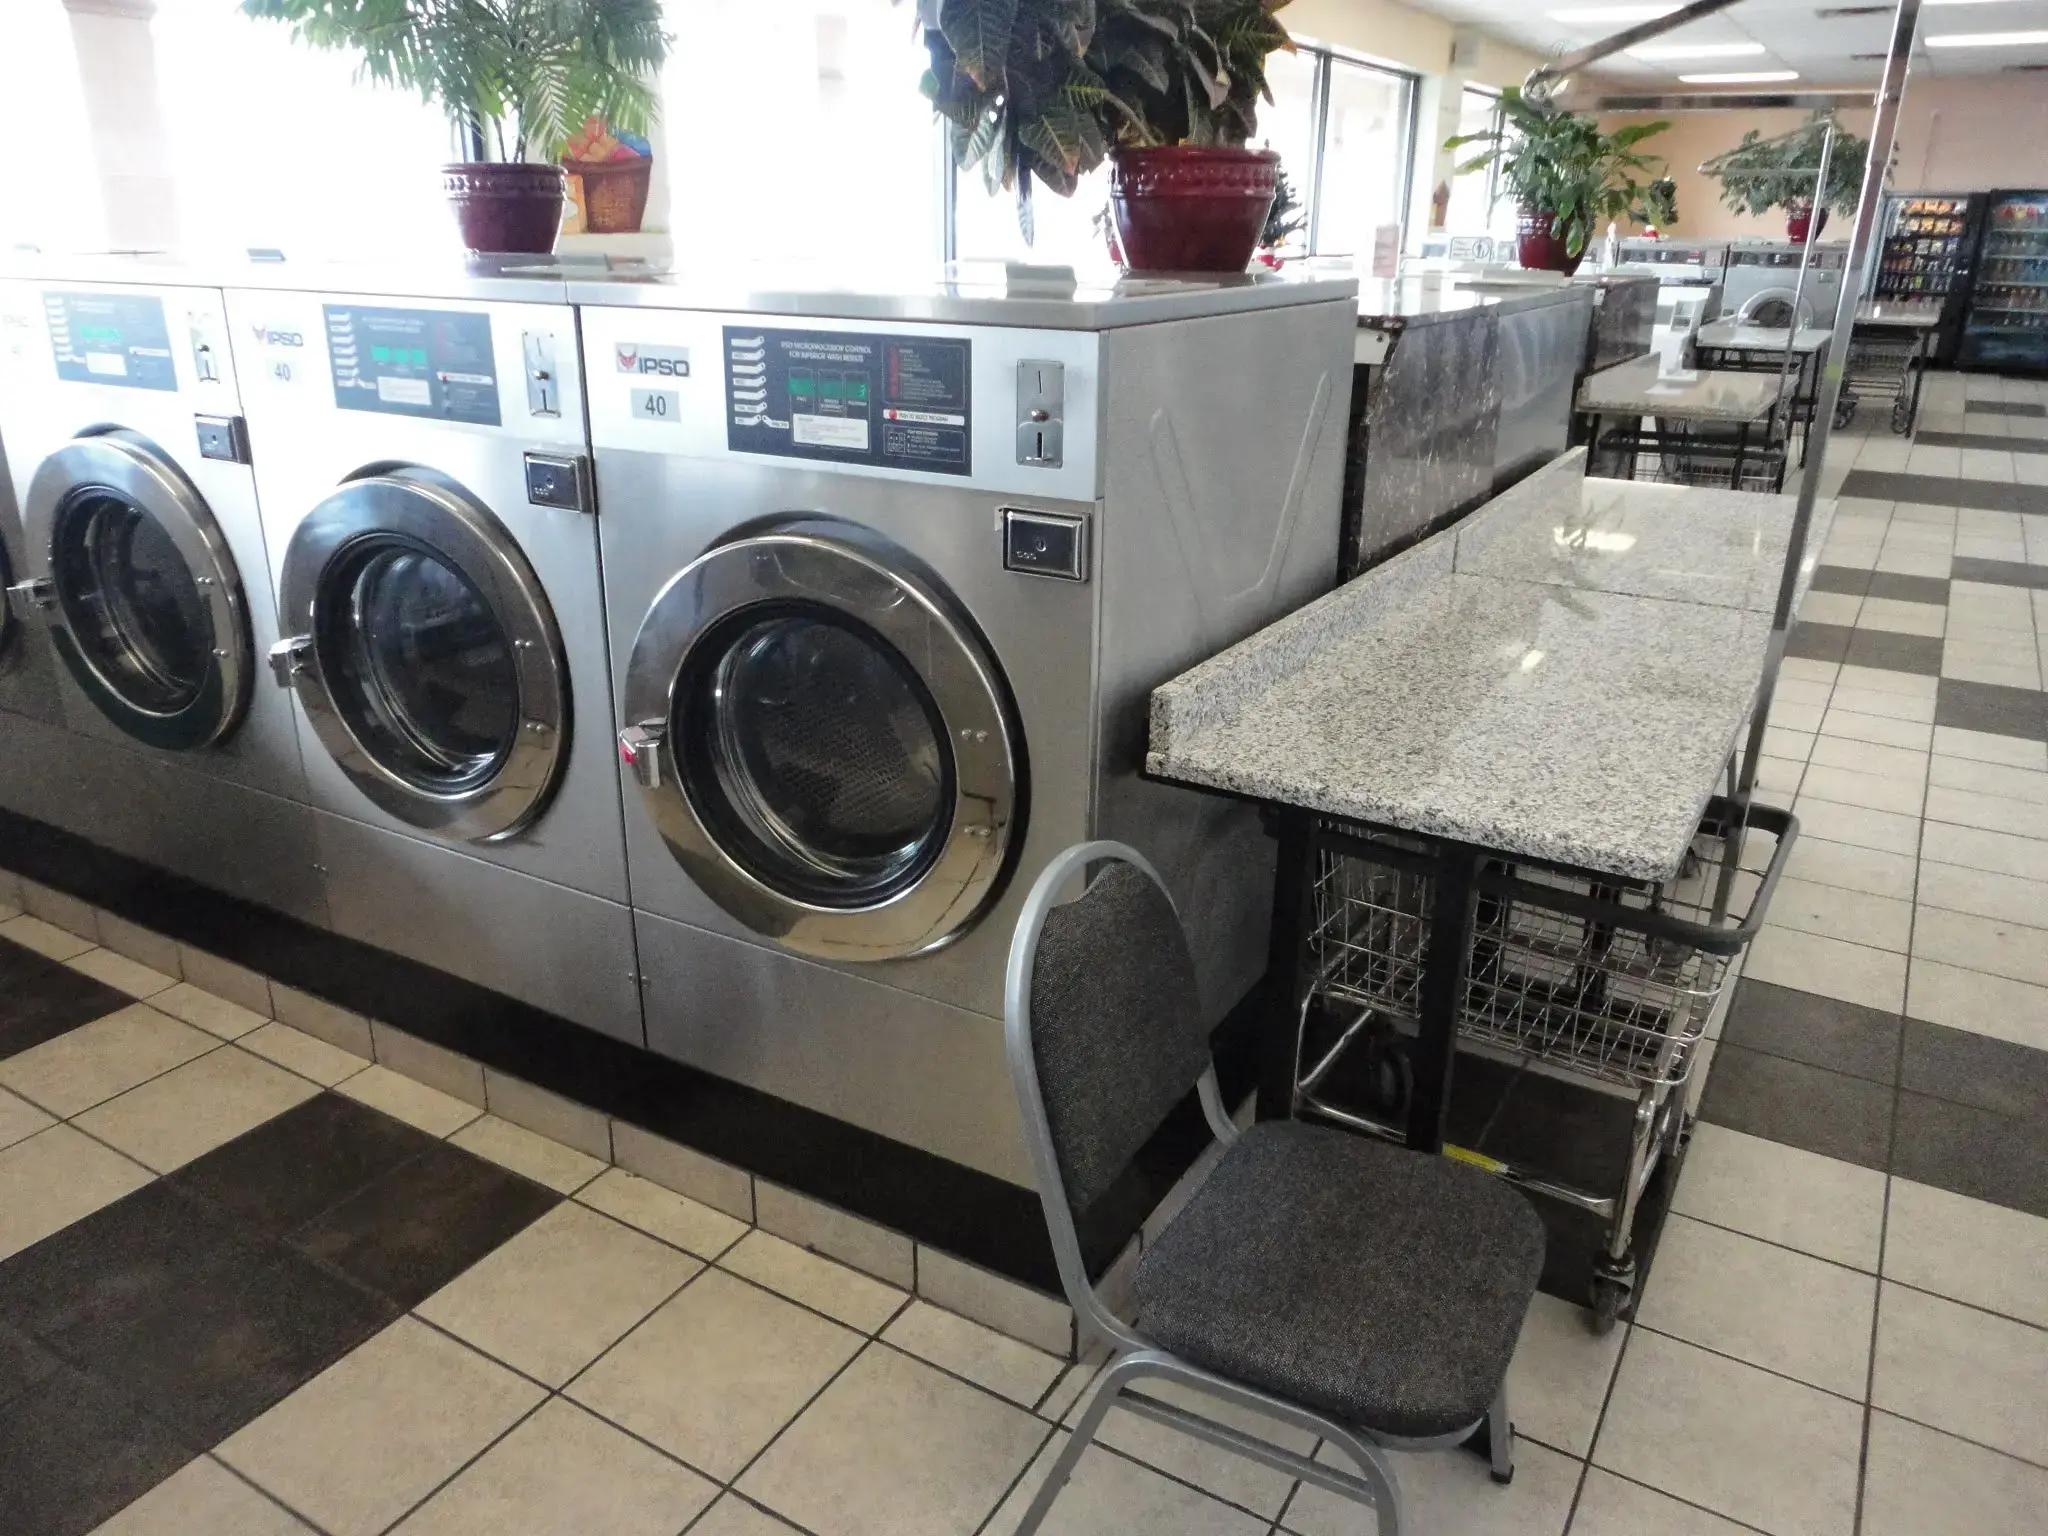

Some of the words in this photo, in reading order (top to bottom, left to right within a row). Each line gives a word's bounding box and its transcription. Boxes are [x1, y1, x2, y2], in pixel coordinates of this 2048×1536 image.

[275, 363, 291, 381] 40
[639, 356, 690, 377] IPSO
[645, 393, 666, 416] 40
